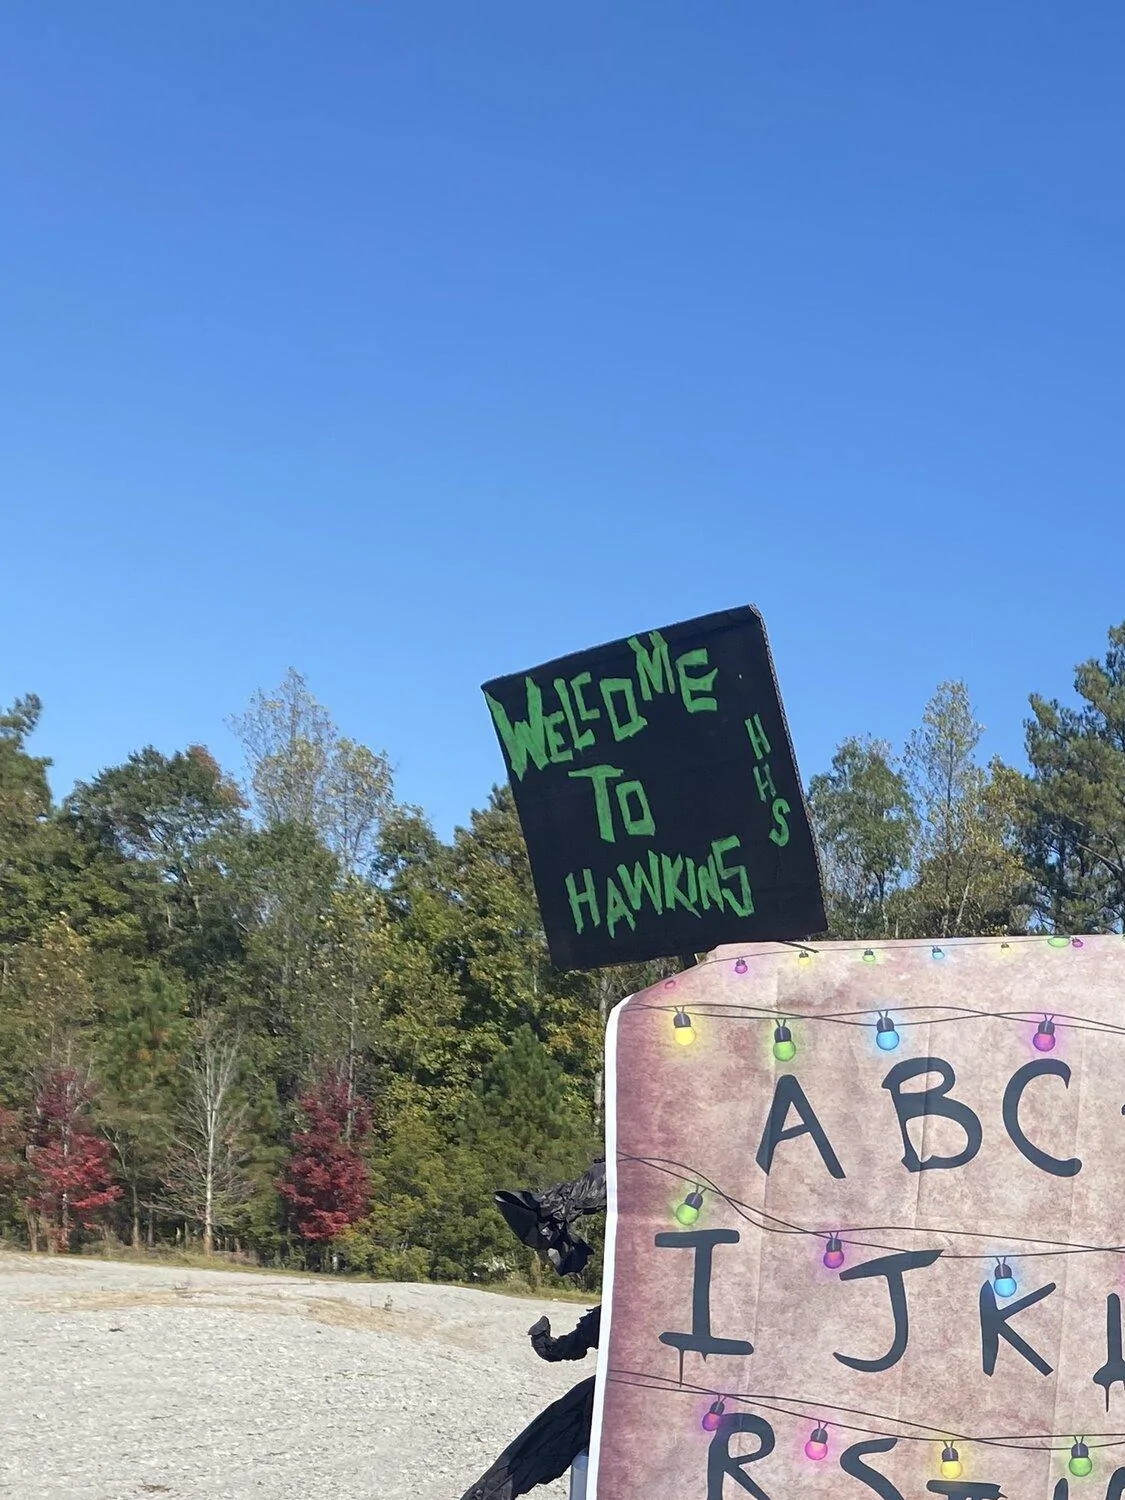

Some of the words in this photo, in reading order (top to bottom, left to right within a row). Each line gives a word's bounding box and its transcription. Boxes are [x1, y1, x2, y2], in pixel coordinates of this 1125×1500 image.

[484, 631, 718, 782] WELCOME
[568, 764, 657, 843] TO
[565, 835, 754, 939] HAWKINS
